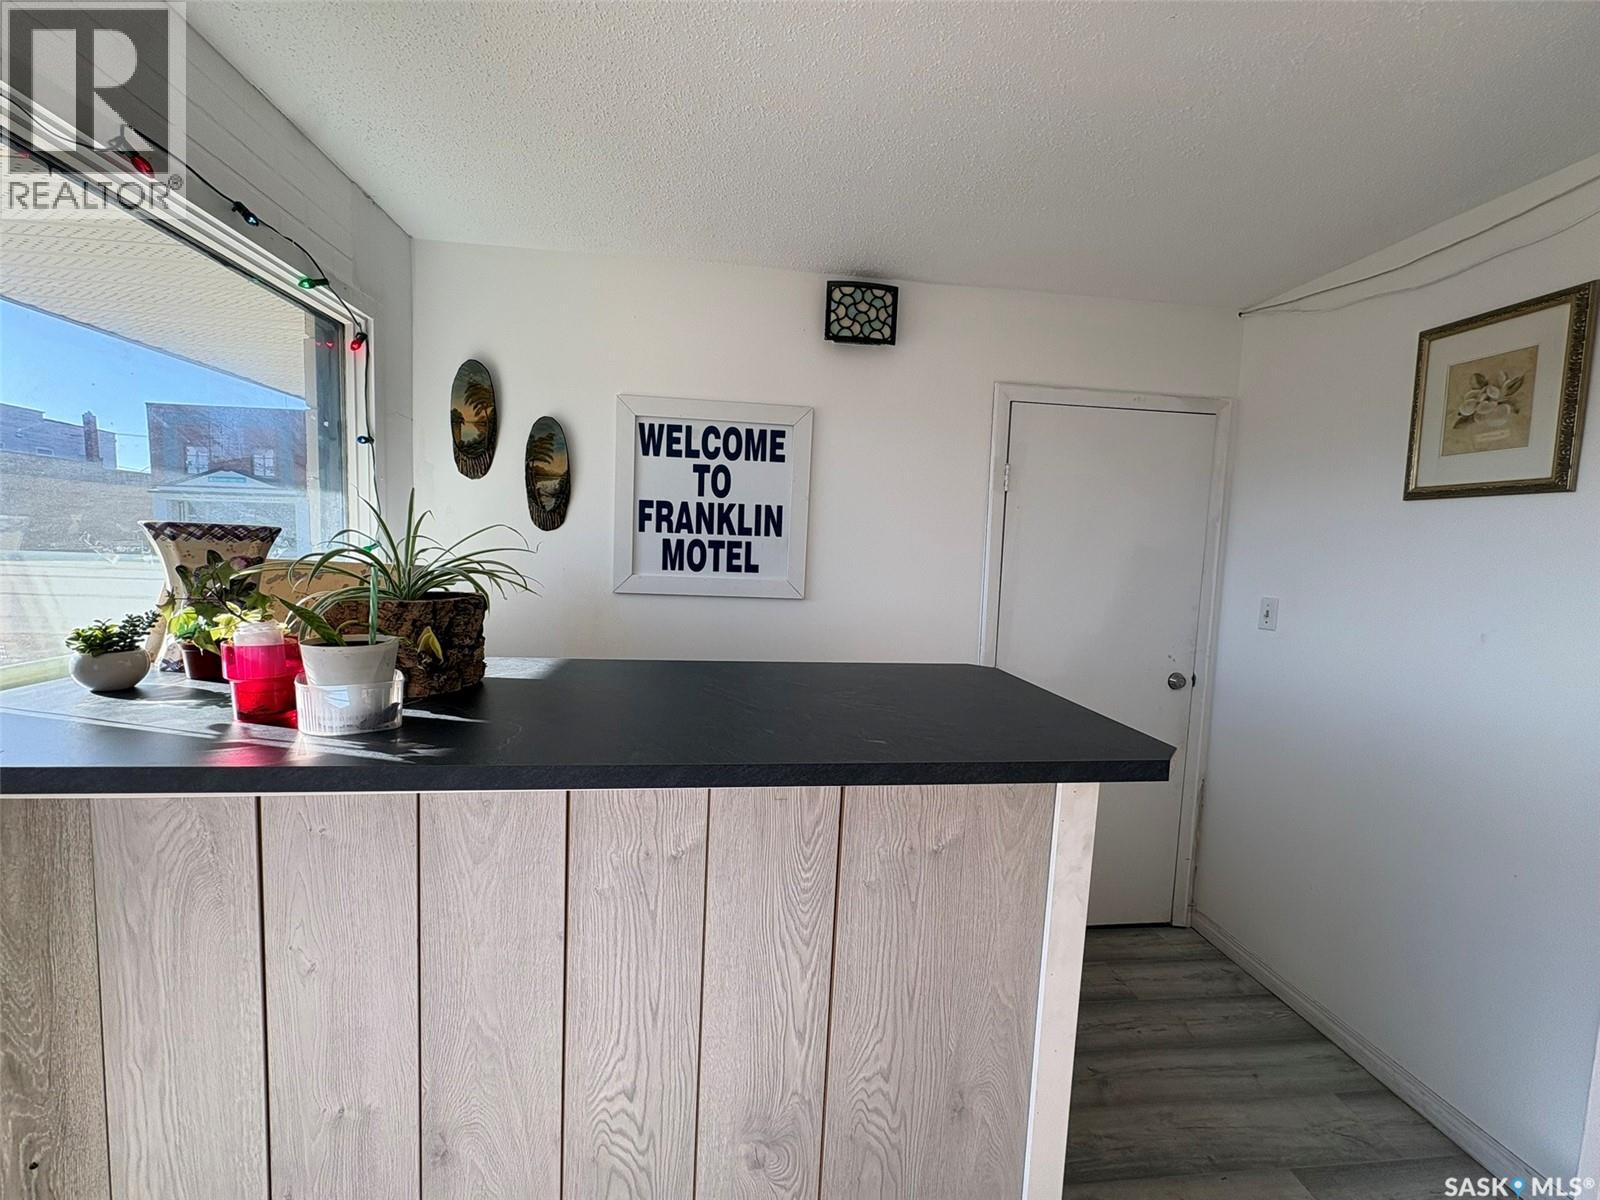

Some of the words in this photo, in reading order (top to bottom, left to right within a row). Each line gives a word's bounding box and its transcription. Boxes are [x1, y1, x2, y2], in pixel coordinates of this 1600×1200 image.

[638, 422, 786, 463] WELCOME
[692, 463, 732, 499] TO
[638, 499, 784, 538] FRANKLIN
[661, 538, 760, 574] MOTEL
